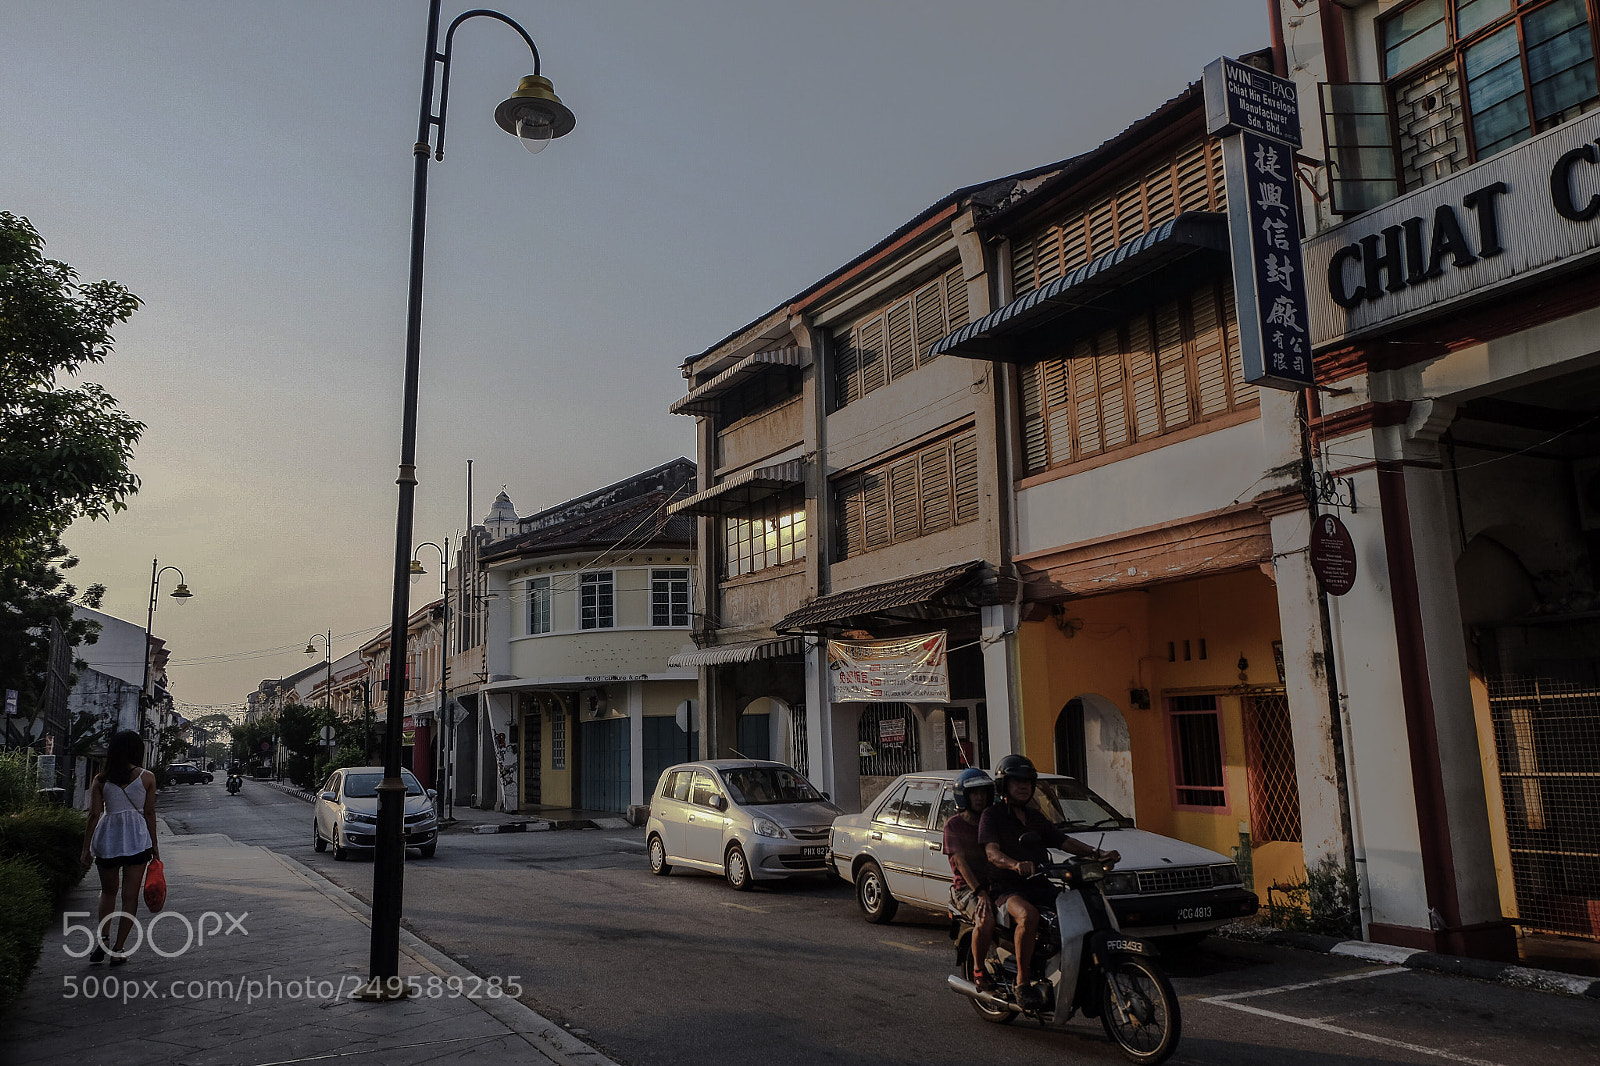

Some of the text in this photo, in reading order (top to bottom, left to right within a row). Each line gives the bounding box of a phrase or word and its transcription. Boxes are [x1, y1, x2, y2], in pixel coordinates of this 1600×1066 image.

[1226, 64, 1296, 103] WIN PAQ
[1228, 81, 1296, 115] Chiat Hin Envelope
[1239, 98, 1287, 125] Manufacturer
[1247, 114, 1283, 136] Sdn. Bhd.
[1328, 137, 1600, 309] CHIAT C
[1272, 330, 1288, 371] 有限
[1289, 336, 1305, 375] 公司
[1194, 906, 1212, 919] 4813
